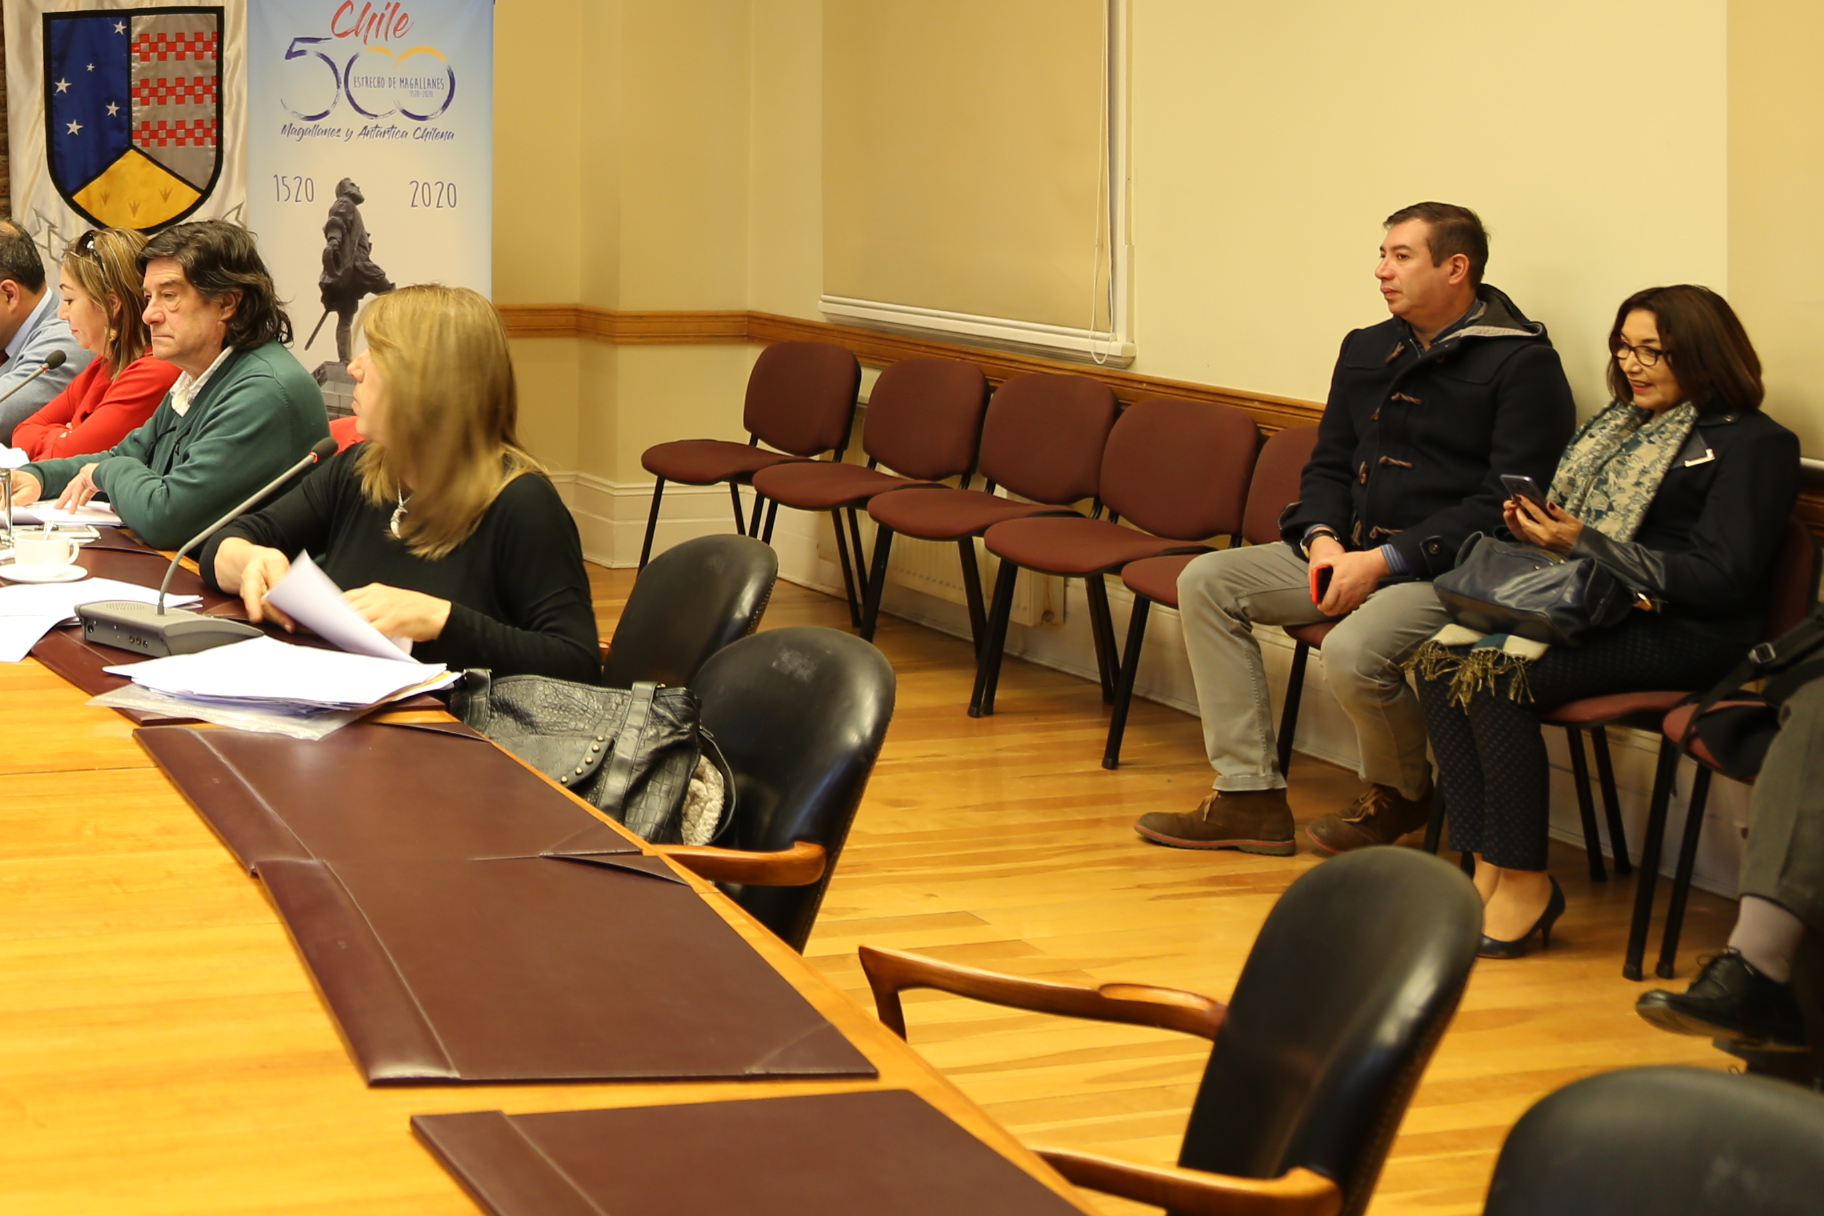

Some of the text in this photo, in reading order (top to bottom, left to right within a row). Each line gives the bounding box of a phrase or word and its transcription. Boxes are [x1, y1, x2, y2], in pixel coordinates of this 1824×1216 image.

[330, 0, 414, 45] Chile
[280, 37, 456, 121] 500
[353, 76, 445, 90] ESTRECHO DE MAGALLANES
[409, 90, 434, 98] 1520-2020
[280, 123, 341, 142] Magallanes
[345, 129, 354, 142] y
[412, 126, 455, 142] Chilena
[273, 174, 315, 203] 1520
[409, 180, 457, 208] 2020
